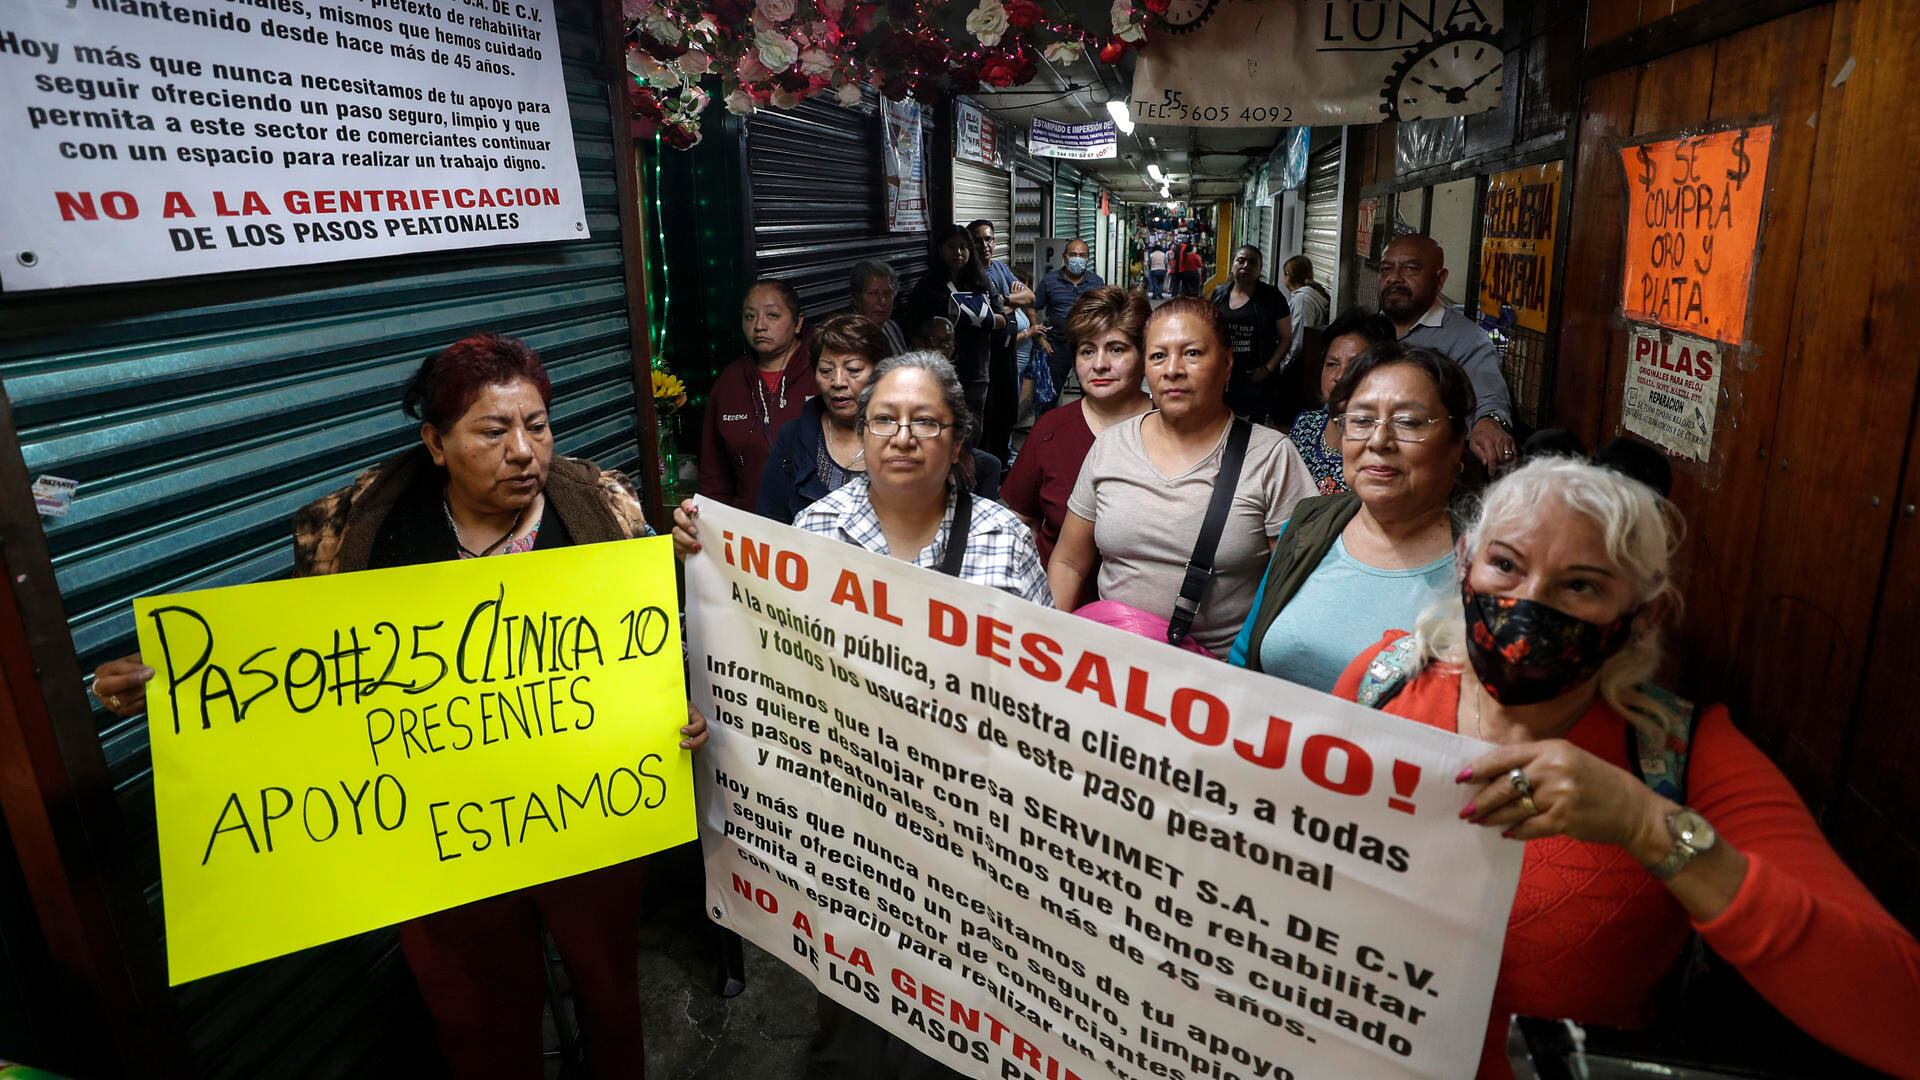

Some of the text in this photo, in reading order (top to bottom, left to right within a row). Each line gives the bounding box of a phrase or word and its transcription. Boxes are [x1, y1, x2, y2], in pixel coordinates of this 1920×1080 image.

[261, 19, 515, 76] desde hace más 45 años.
[319, 6, 541, 61] mismos que hemos cuidado
[470, 16, 542, 41] rehabilitar
[1323, 0, 1488, 41] LUNA
[35, 74, 540, 133] seguir ofreciendo paso seguro, limpio que
[74, 45, 550, 114] más que nunca necesitamos apoyo para
[1164, 89, 1182, 110] 55
[27, 106, 550, 151] permita este sector comerciantes continuar
[1033, 119, 1066, 133] ESTAMPADO
[1179, 104, 1229, 122] 5605
[1239, 106, 1293, 122] 4092
[59, 142, 545, 172] con espacio para realizar trabajo digno.
[1673, 138, 1706, 184] SE
[55, 188, 560, 221] NO A LA GENTRIFICACION
[168, 213, 519, 251] DE LOS PASOS PEATONALES
[1645, 181, 1733, 230] COMPRA
[1651, 232, 1685, 269] ORO
[1641, 272, 1709, 324] PLATA.
[1635, 336, 1713, 381] PILAS
[1639, 366, 1704, 392] ORIGINALES PARA RELOJ
[1648, 389, 1685, 414] REPARACION
[456, 580, 604, 685] CLINICA
[617, 605, 669, 662] 10
[723, 530, 1421, 824] ¡NO AL DESALOJO!
[365, 675, 595, 766] PRESENTES
[766, 604, 1410, 873] opinión pública, nuestra clientela, todas
[774, 631, 1333, 891] todos usuarios este paso peatonal
[201, 754, 668, 866] APOYO ESTAMOS
[707, 654, 1438, 1006] Informamos que empresa SERVIMET S.A. DE C.V.
[712, 684, 1434, 1032] nos quiere desalojar con pretexto rehabilitar
[715, 768, 1085, 984] Hoy más que nunca necesitamos
[716, 705, 1412, 1057] los pasos peatonales, mismos que hemos cuidado
[724, 819, 951, 950] permita este sector
[732, 872, 875, 976] NO LA
[733, 800, 1129, 1040] seguir ofreciendo paso seguro,
[774, 748, 1316, 1044] mantenido desde hace más 45 años.
[806, 886, 1056, 1033] espacio para realizar
[830, 962, 989, 1064] LOS PASOS
